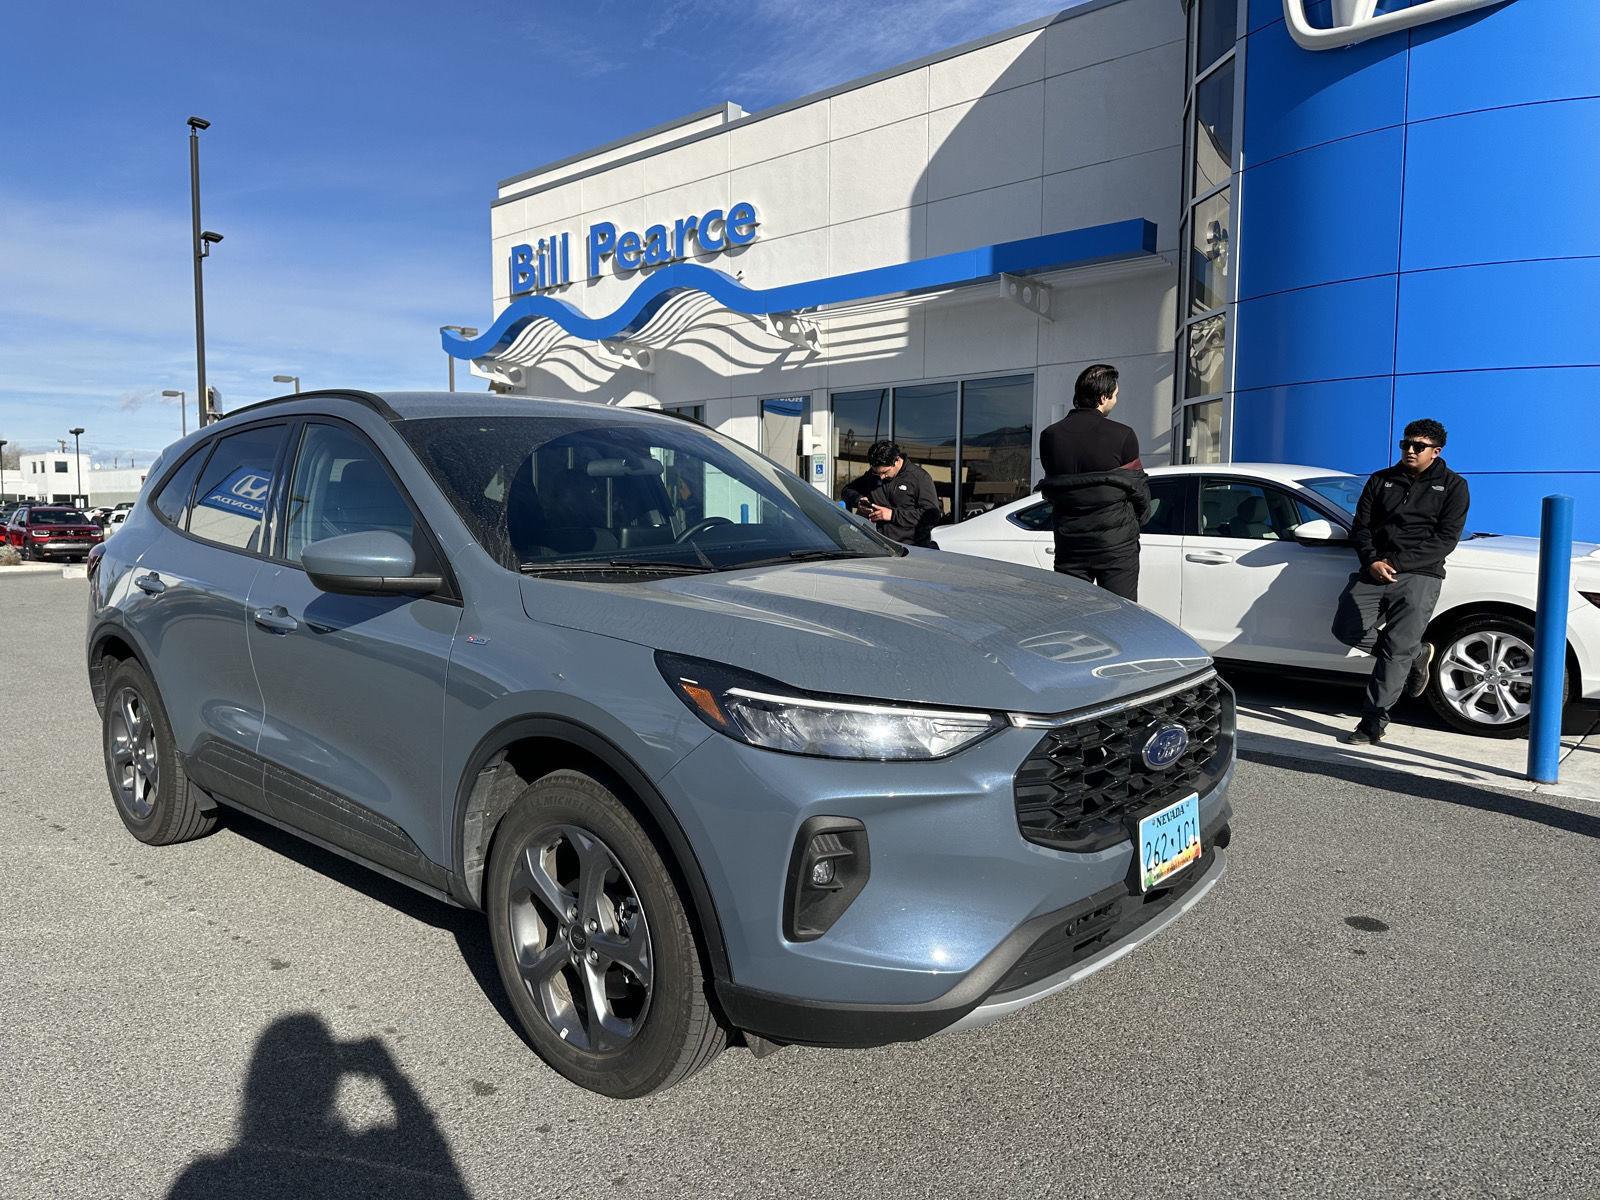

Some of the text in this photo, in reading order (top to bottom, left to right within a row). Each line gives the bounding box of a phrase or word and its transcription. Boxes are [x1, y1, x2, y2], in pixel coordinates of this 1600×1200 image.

[511, 201, 757, 295] Bill Pearce
[1156, 804, 1185, 828] NEVADA
